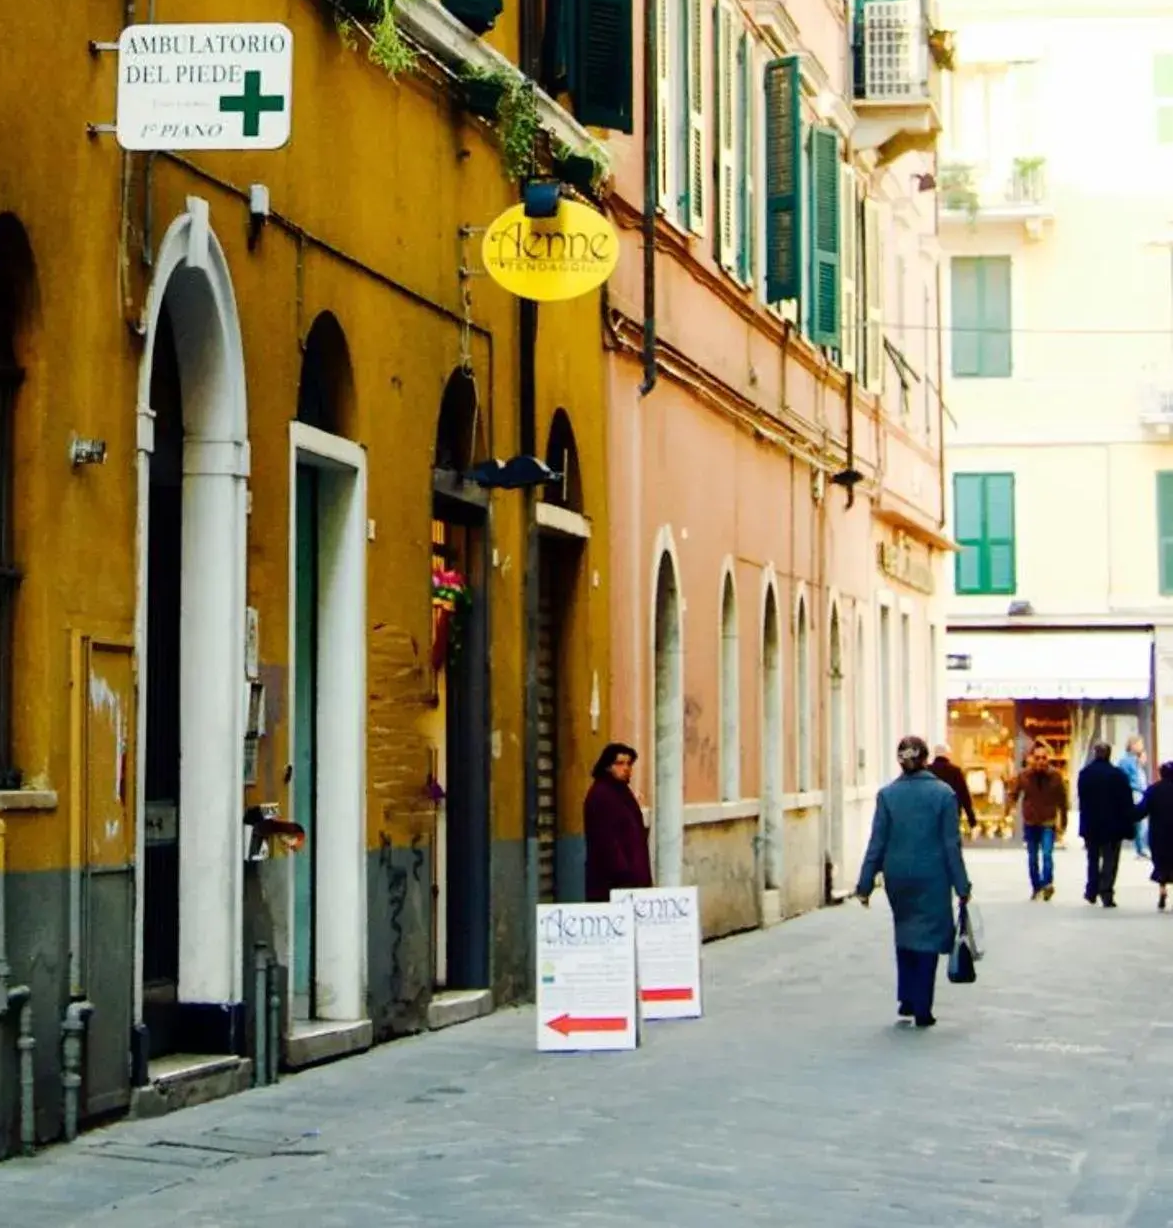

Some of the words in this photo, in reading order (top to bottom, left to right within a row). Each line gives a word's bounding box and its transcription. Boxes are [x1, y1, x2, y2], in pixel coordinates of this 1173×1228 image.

[126, 34, 285, 55] AMBULATORIO
[127, 65, 170, 84] DEL
[176, 64, 242, 83] PIEDE
[160, 123, 223, 138] PIANO
